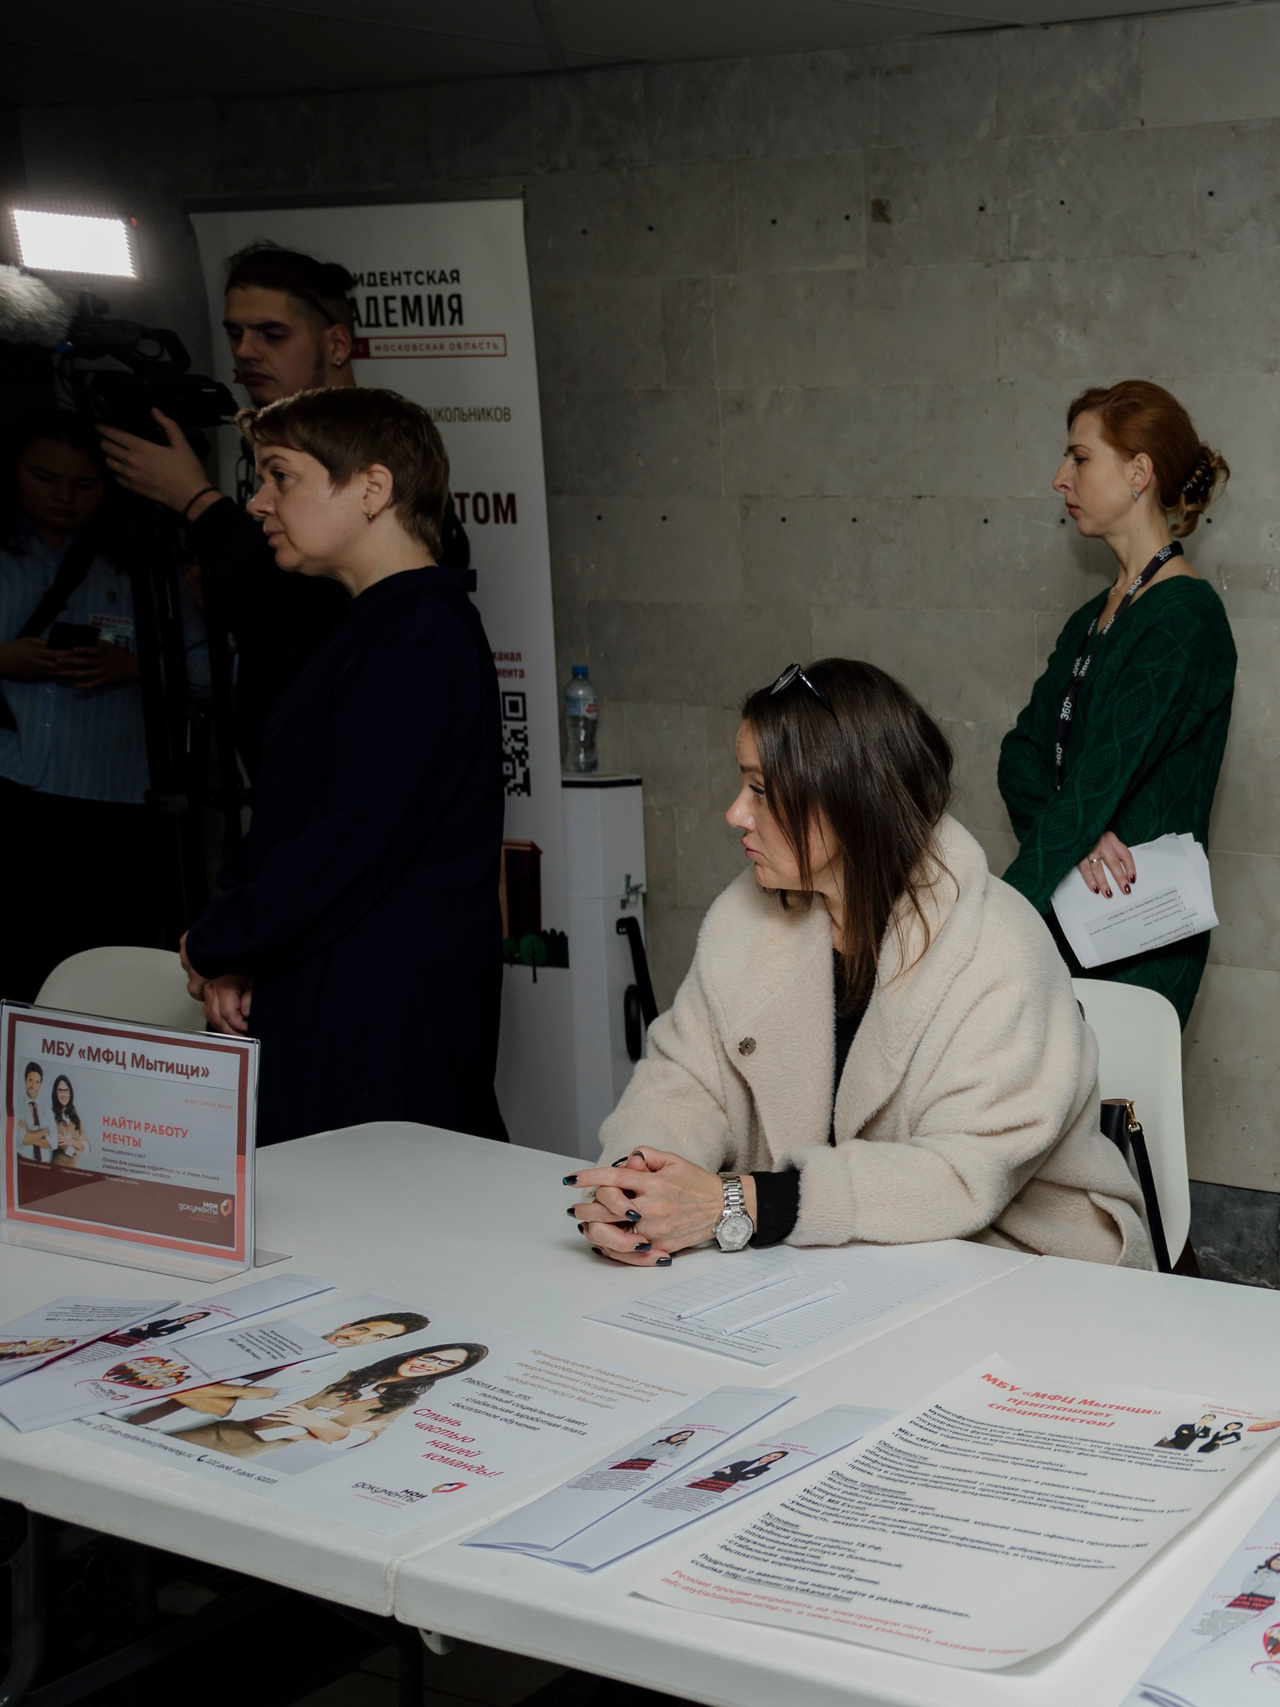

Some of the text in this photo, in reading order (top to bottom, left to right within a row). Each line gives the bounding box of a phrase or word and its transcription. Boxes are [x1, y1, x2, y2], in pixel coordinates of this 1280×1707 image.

[353, 269, 461, 287] ИДЕНТСКАЯ
[350, 293, 464, 328] АДЕМИЯ
[374, 341, 445, 353] МОСКОВСКАЯ
[448, 339, 499, 351] ОБЛАСТЬ
[1060, 696, 1073, 721] 360°
[41, 1038, 210, 1080] МБУ «МФЦ Мытищи»
[102, 1115, 189, 1140] НАЙТИ РАБОТУ
[102, 1131, 142, 1149] МЕЧТЫ
[178, 1202, 219, 1216] документы
[203, 1201, 219, 1209] мои
[461, 1376, 492, 1389] Работа
[981, 1373, 1160, 1414] МБУ «МФЦ Мытищи»
[413, 1408, 461, 1426] Стань
[452, 1402, 540, 1431] бесплатное обучение
[465, 1397, 587, 1435] стабильная заработная плата
[478, 1392, 588, 1426] полный социальный пакет
[988, 1403, 1114, 1427] специалистов!
[1007, 1397, 1112, 1417] приглашает
[414, 1421, 475, 1442] частью
[897, 1427, 913, 1437] МБУ
[977, 1451, 1024, 1460] приглашает
[425, 1439, 480, 1457] нашей
[422, 1452, 503, 1477] команды!
[350, 1481, 419, 1504] документы
[402, 1489, 428, 1500] мои
[735, 1534, 776, 1550] дружный
[744, 1529, 808, 1549] оплачиваемый
[808, 1547, 837, 1555] отпуск
[751, 1524, 791, 1539] удобный
[791, 1537, 821, 1546] график
[760, 1519, 813, 1537] оформление
[814, 1535, 853, 1545] согласно
[690, 1559, 723, 1573] ссылка
[720, 1544, 769, 1562] бесплатное
[770, 1560, 836, 1576] корпоративное
[728, 1540, 778, 1557] стабильная
[779, 1555, 828, 1567] заработная
[699, 1553, 747, 1572] Подробнее
[755, 1572, 796, 1582] вакансии
[809, 1582, 840, 1591] нашем
[841, 1589, 867, 1597] сайте
[875, 1596, 913, 1606] разделе
[671, 1570, 711, 1587] Резюме
[712, 1585, 752, 1596] просим
[752, 1594, 812, 1608] направлять
[830, 1609, 900, 1626] электронную
[901, 1623, 934, 1635] почту
[806, 1612, 831, 1620] теме
[832, 1617, 873, 1629] письма
[874, 1626, 930, 1642] указывать
[934, 1640, 986, 1652] название
